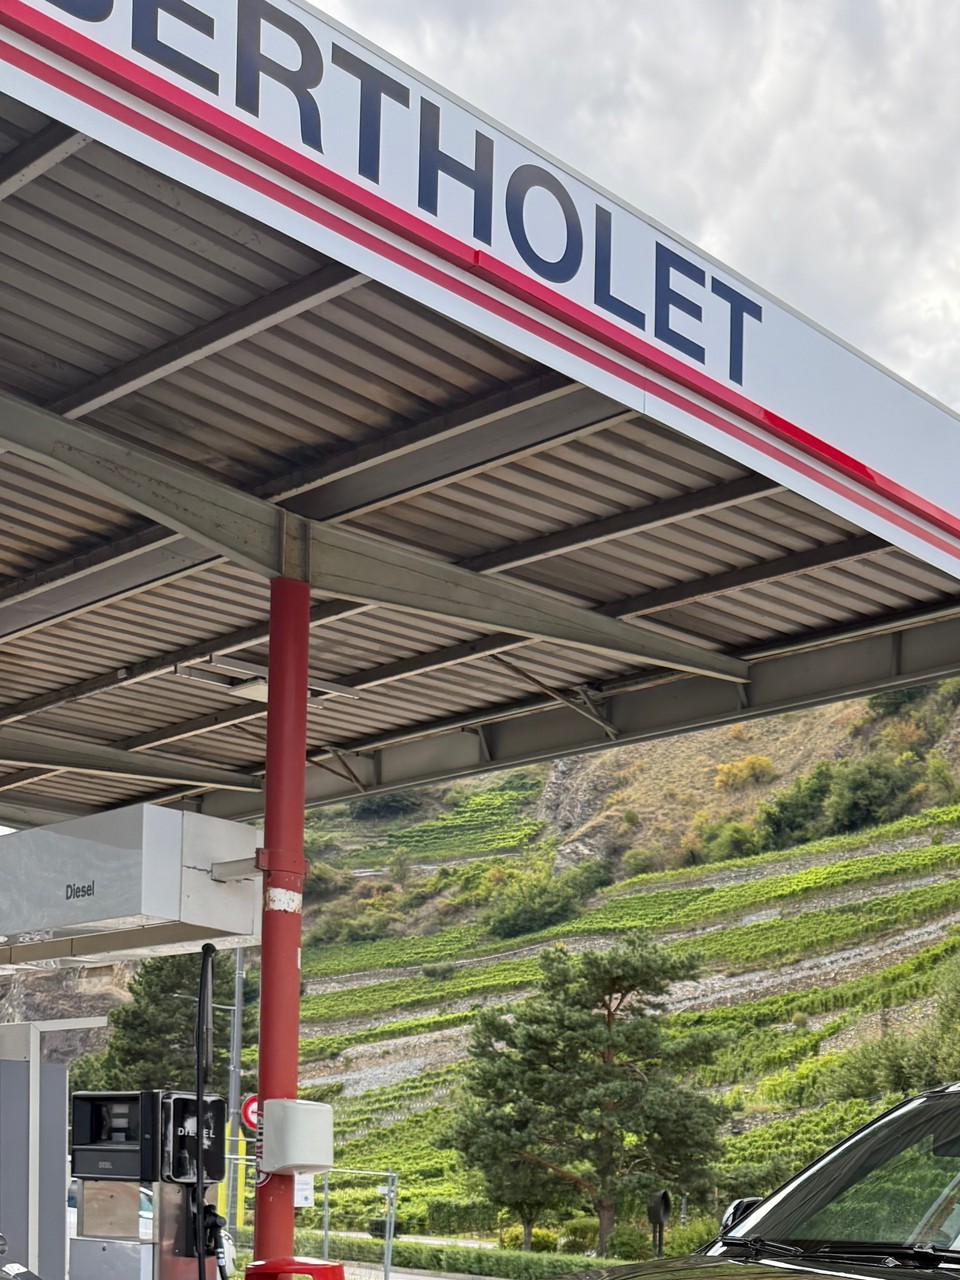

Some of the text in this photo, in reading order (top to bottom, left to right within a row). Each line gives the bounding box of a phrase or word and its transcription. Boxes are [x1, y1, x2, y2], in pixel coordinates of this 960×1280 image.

[44, 0, 763, 387] ERTHOLET
[66, 880, 95, 900] Diesel
[178, 1127, 215, 1138] DIEEL
